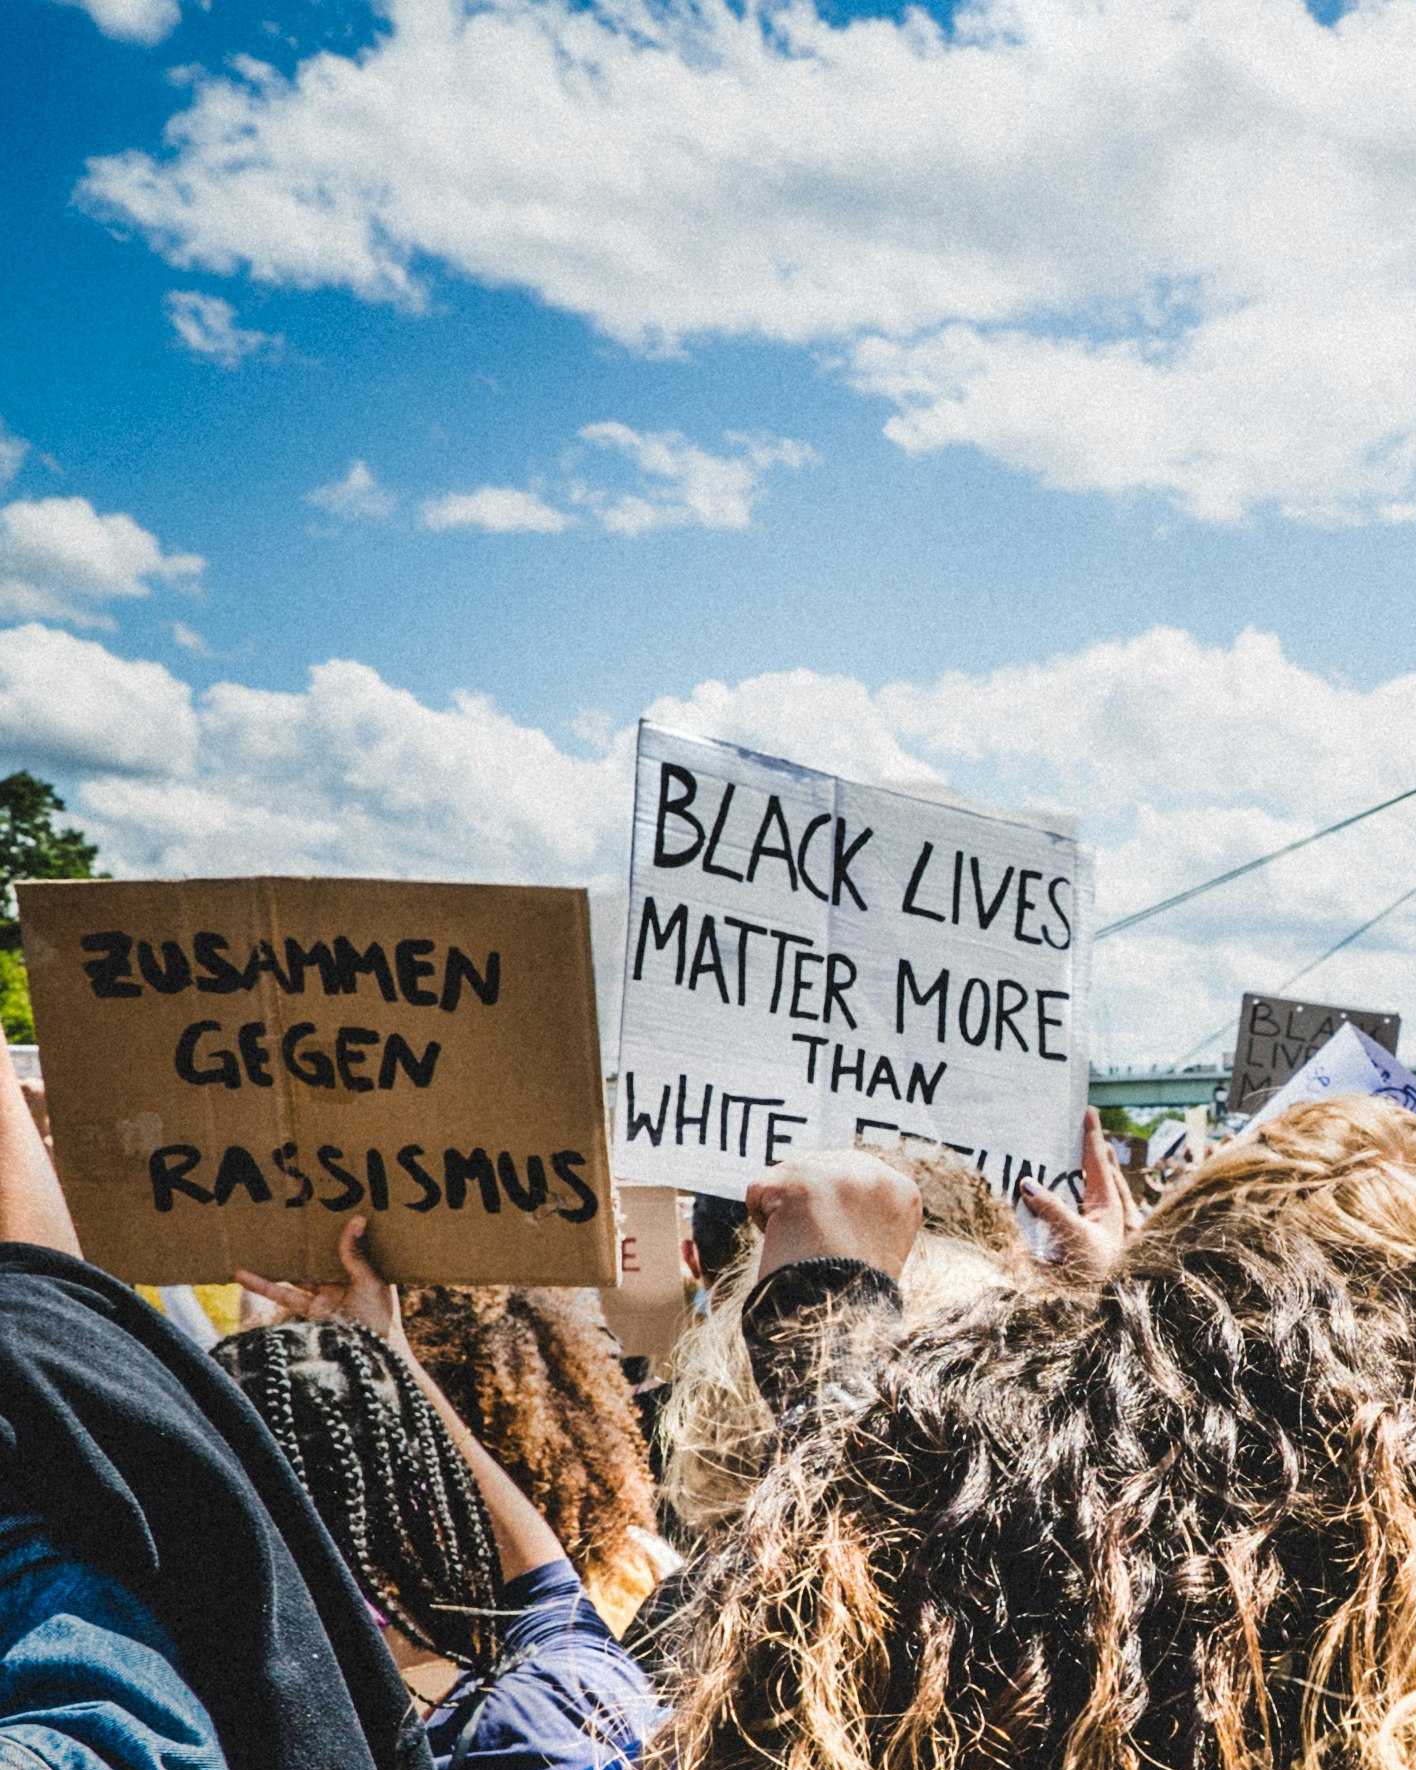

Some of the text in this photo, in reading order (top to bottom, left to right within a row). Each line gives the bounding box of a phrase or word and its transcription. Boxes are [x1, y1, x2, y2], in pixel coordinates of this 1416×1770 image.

[653, 761, 1072, 951] BLACK LIVES
[80, 930, 501, 1012] ZUSAMMEN
[633, 896, 1071, 1062] MATTER MORE
[174, 1020, 441, 1092] GEGEN
[792, 1033, 948, 1106] THAN
[625, 1071, 809, 1167] WHITE
[148, 1143, 598, 1225] RASSISMUS
